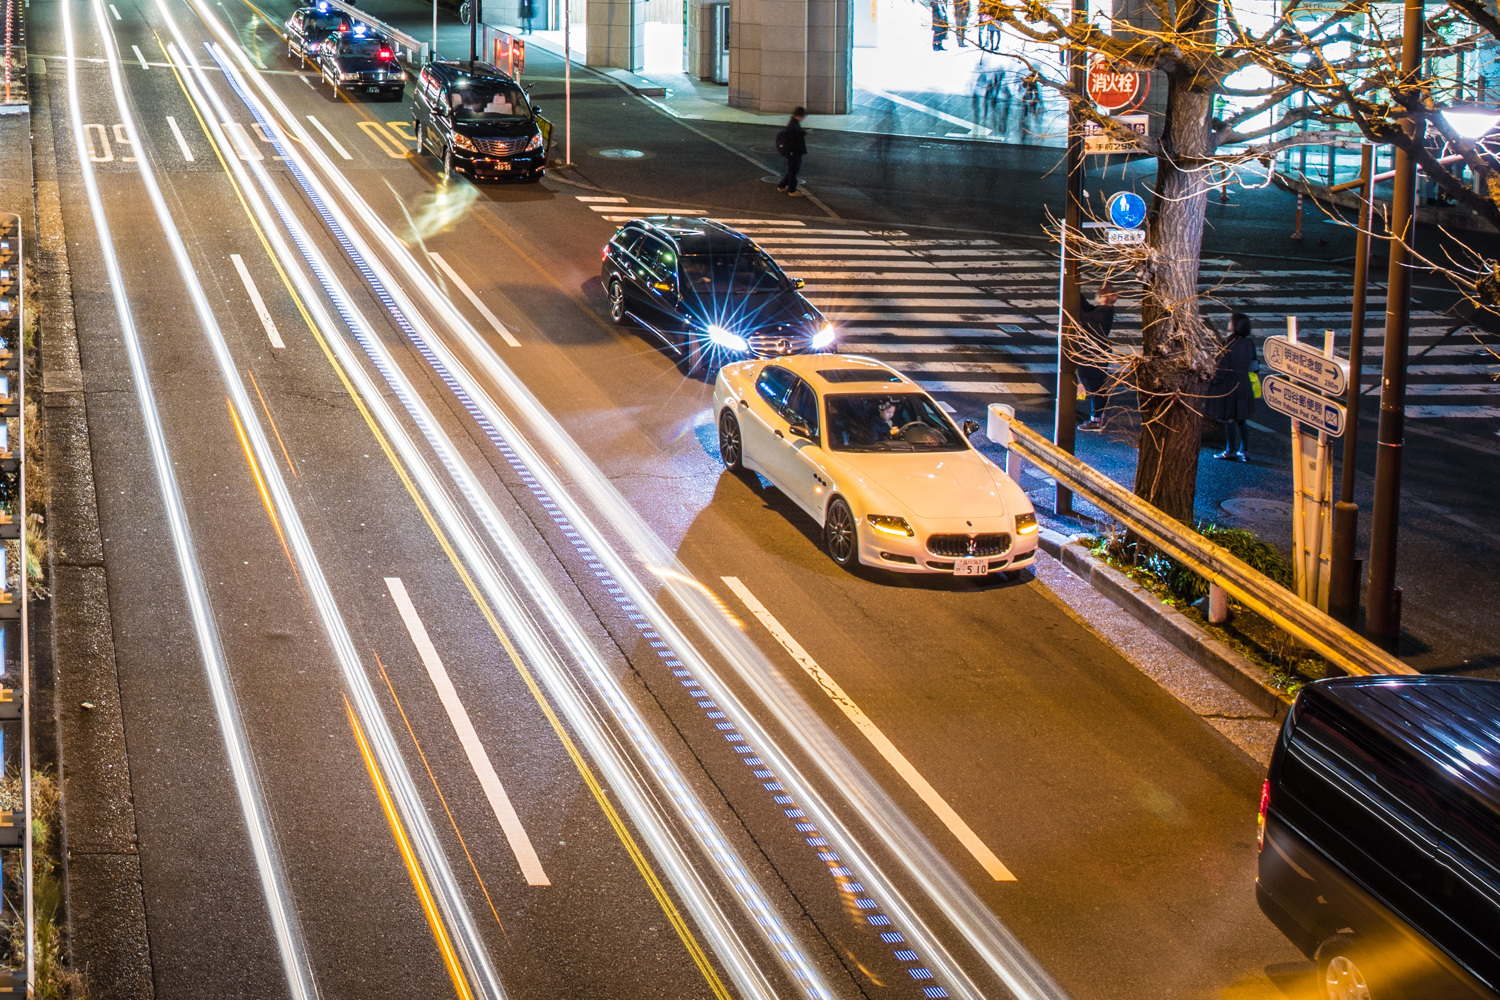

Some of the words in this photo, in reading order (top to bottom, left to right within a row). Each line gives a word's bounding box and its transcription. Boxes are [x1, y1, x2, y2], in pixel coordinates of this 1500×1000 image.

[1092, 72, 1134, 93] 消火栓
[1284, 347, 1323, 375] 明治記念館
[1286, 363, 1298, 374] Meiji
[1299, 369, 1319, 383] Kinenkan
[1324, 379, 1339, 391] 280m
[1268, 395, 1282, 406] 230m
[1299, 408, 1310, 419] Post
[1311, 414, 1324, 426] Office
[1283, 387, 1322, 415] 四谷郵便局
